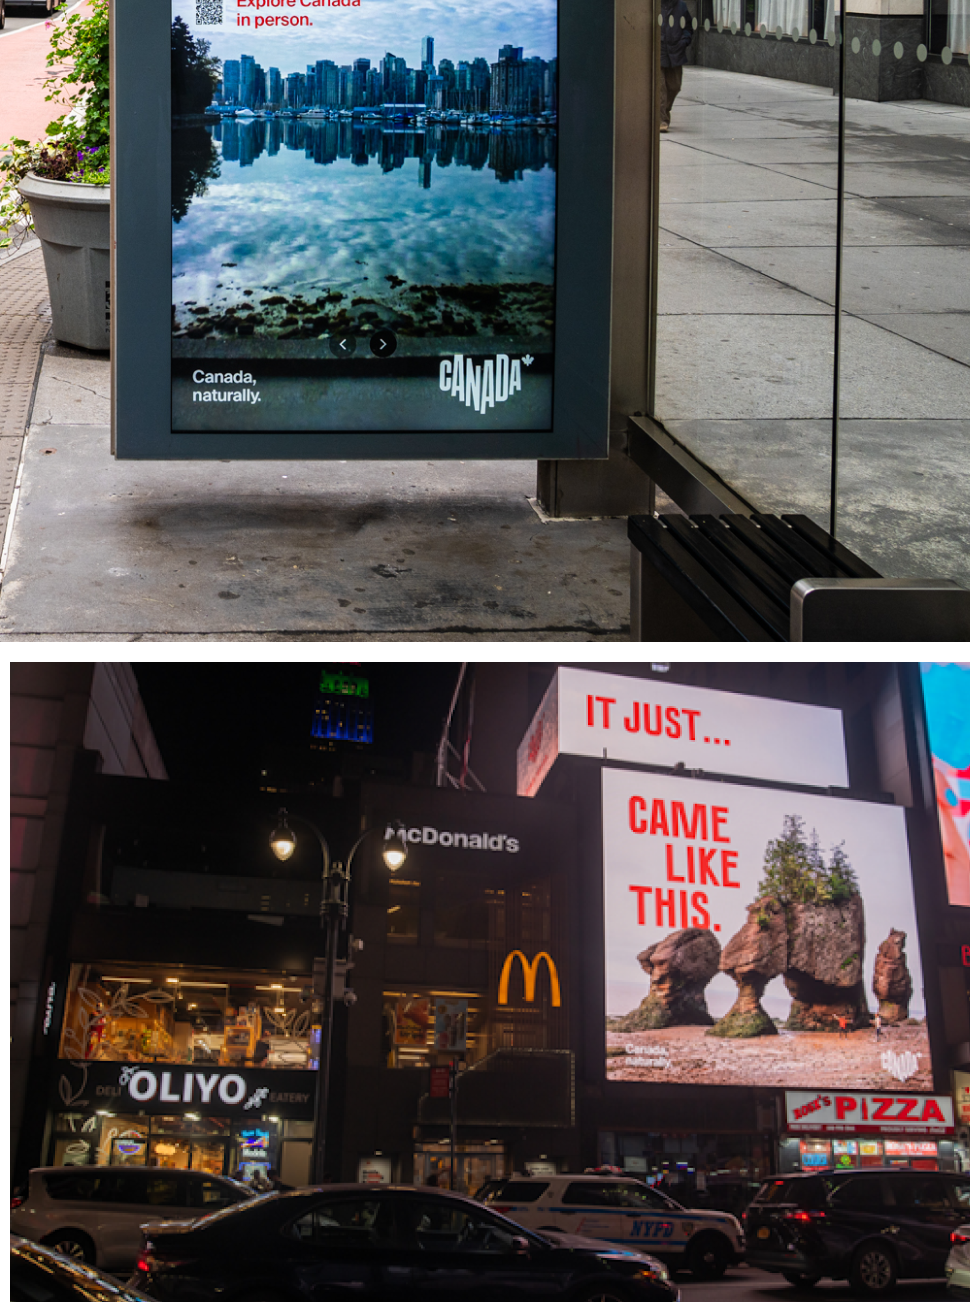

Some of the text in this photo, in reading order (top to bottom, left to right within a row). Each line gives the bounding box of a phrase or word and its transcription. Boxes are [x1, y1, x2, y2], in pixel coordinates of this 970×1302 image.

[236, 12, 314, 30] in person.
[192, 369, 258, 388] Canada,
[439, 353, 522, 415] CANADA
[192, 388, 262, 405] naturally.
[586, 694, 731, 747] IT JUST...
[628, 795, 731, 844] CAME
[384, 825, 520, 854] McDonald's
[666, 844, 741, 889] LIKE
[629, 885, 722, 932] THIS.
[95, 1069, 311, 1105] DELI OLIYO EATERY
[834, 1095, 947, 1123] PIZZA
[630, 1219, 675, 1238] NYPD
